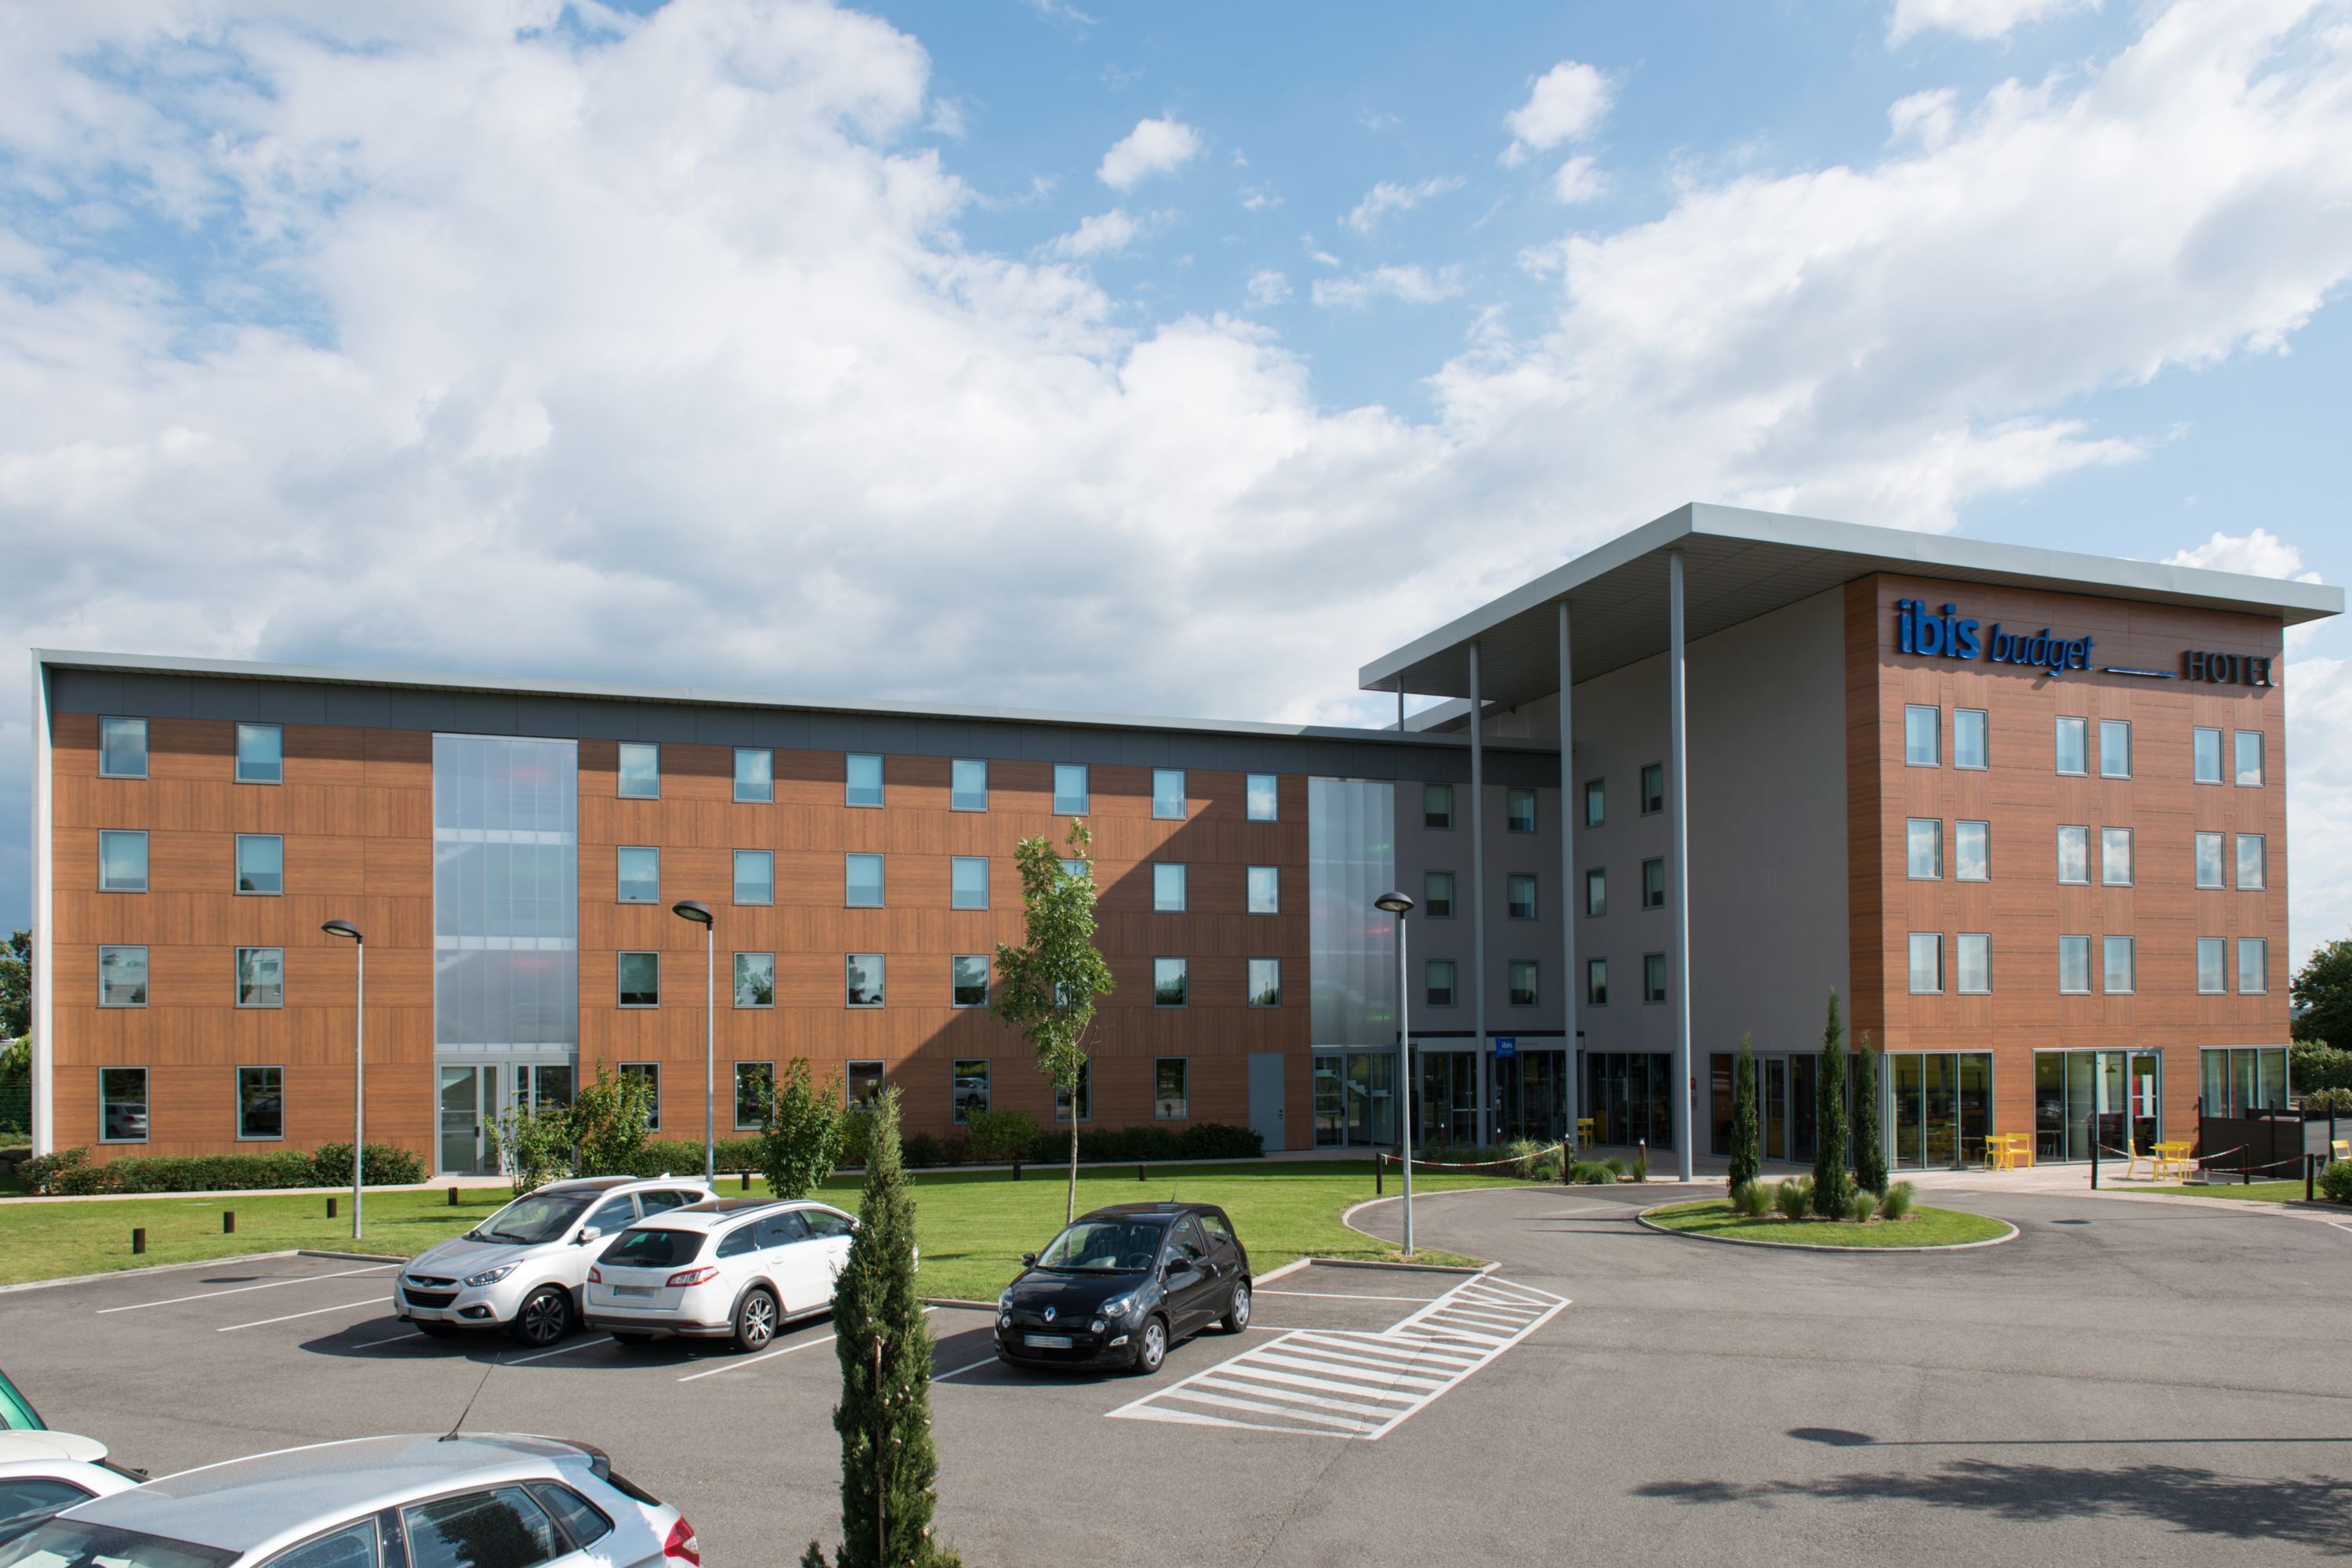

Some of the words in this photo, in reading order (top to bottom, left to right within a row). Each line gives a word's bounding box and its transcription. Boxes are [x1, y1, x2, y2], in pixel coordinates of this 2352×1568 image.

[1898, 598, 1980, 659] ibis
[1991, 622, 2096, 677] budget
[2183, 650, 2280, 687] HOTEL
